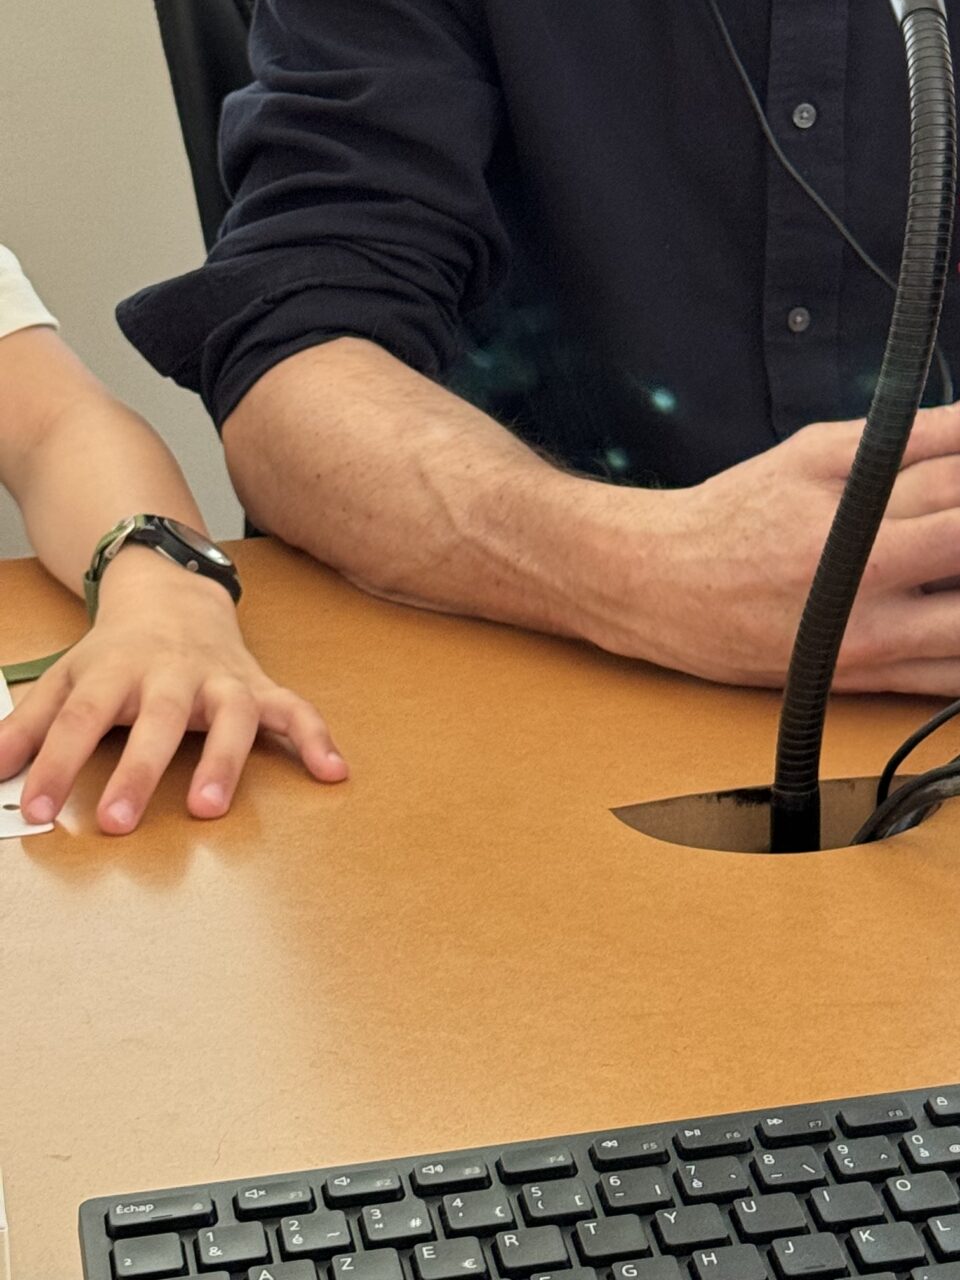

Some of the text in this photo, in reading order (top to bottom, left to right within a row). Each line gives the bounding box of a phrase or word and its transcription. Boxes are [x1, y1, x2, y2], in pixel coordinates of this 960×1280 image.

[643, 1142, 658, 1150] F5
[837, 1144, 848, 1154] 9
[763, 1154, 775, 1164] 8
[686, 1165, 696, 1175] 7
[609, 1176, 621, 1186] 6
[531, 1187, 542, 1197] 5
[116, 1203, 154, 1214] Échap
[452, 1198, 464, 1208] 4
[741, 1201, 757, 1213] U
[370, 1209, 381, 1219] 3
[664, 1211, 677, 1224] Y
[289, 1220, 300, 1231] 2
[584, 1223, 597, 1234] T
[936, 1220, 950, 1231] L
[206, 1232, 215, 1242] 1
[504, 1235, 519, 1247] R
[859, 1230, 875, 1242] K
[422, 1246, 436, 1258] E
[785, 1241, 794, 1253] J
[340, 1257, 354, 1270] Z
[701, 1252, 718, 1266] H
[258, 1270, 274, 1280] A
[621, 1264, 638, 1277] G
